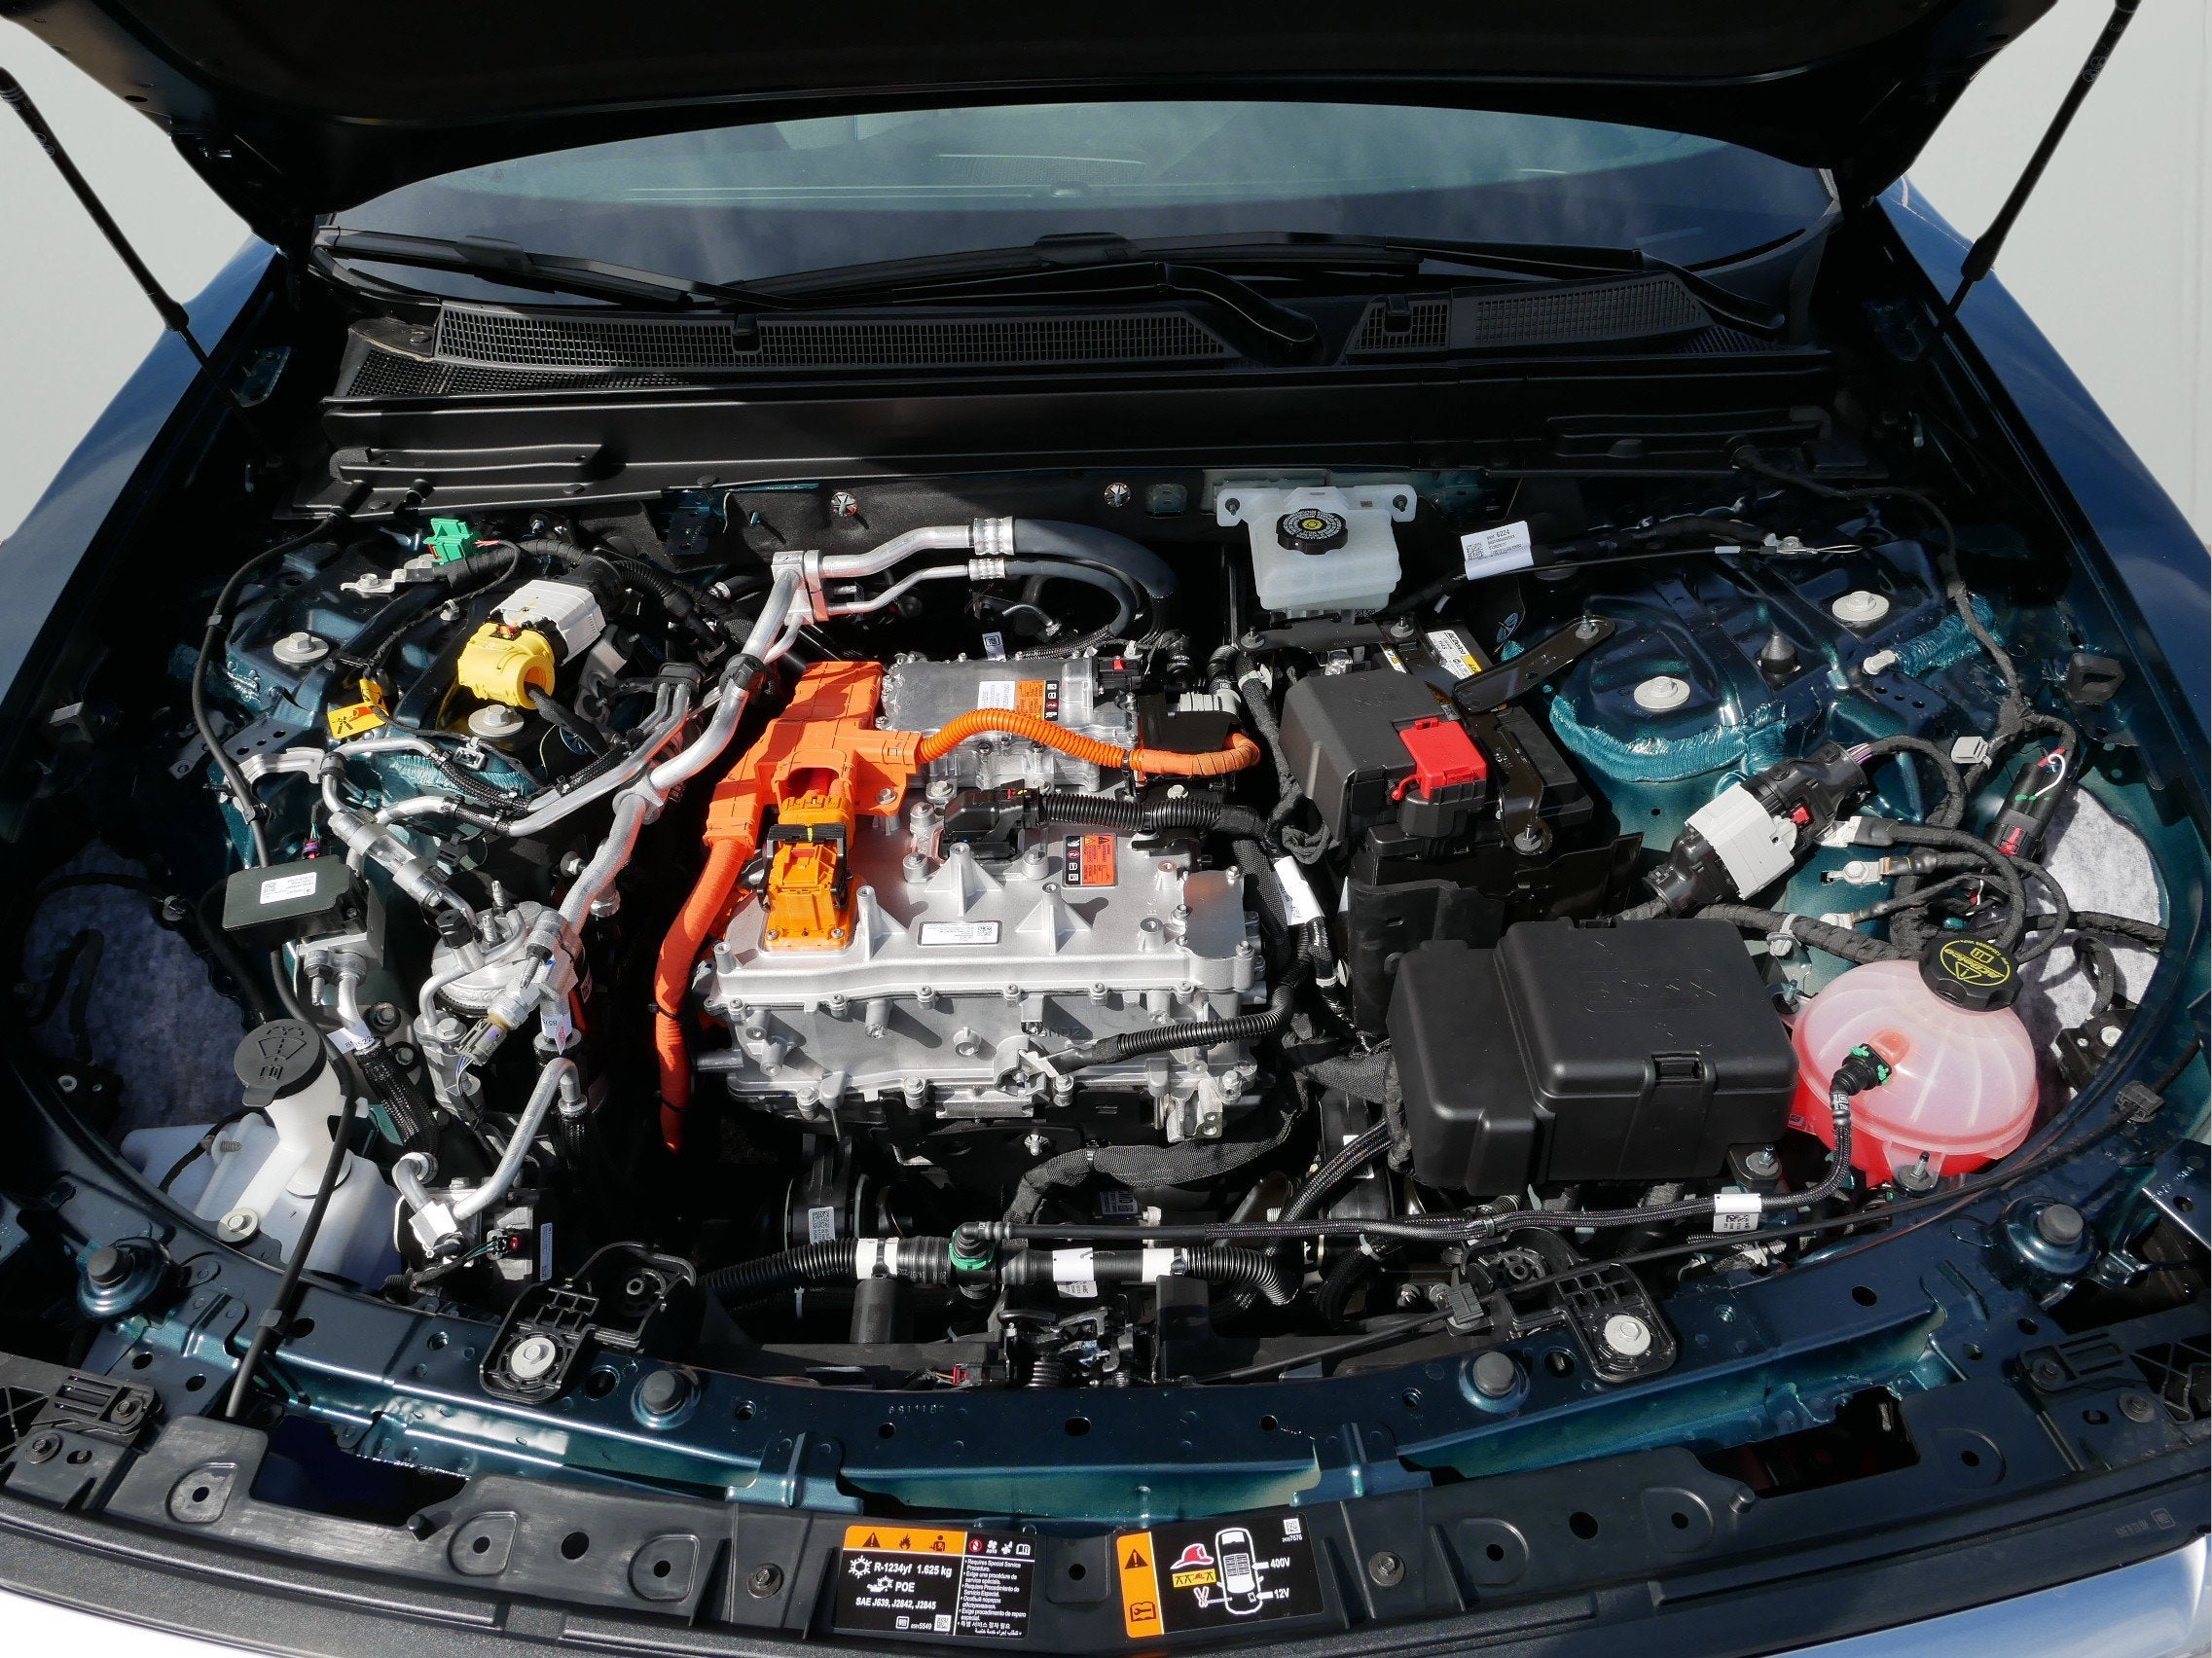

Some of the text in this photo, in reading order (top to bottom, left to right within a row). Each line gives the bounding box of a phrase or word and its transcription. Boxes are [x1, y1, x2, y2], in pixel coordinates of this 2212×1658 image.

[1270, 1557, 1290, 1568] 400V
[874, 1562, 953, 1578] R-1234yf 1.625 kg
[895, 1581, 916, 1593] POE
[1274, 1588, 1290, 1599] 12V
[855, 1597, 937, 1610] SAE J639, J2842, J2845
